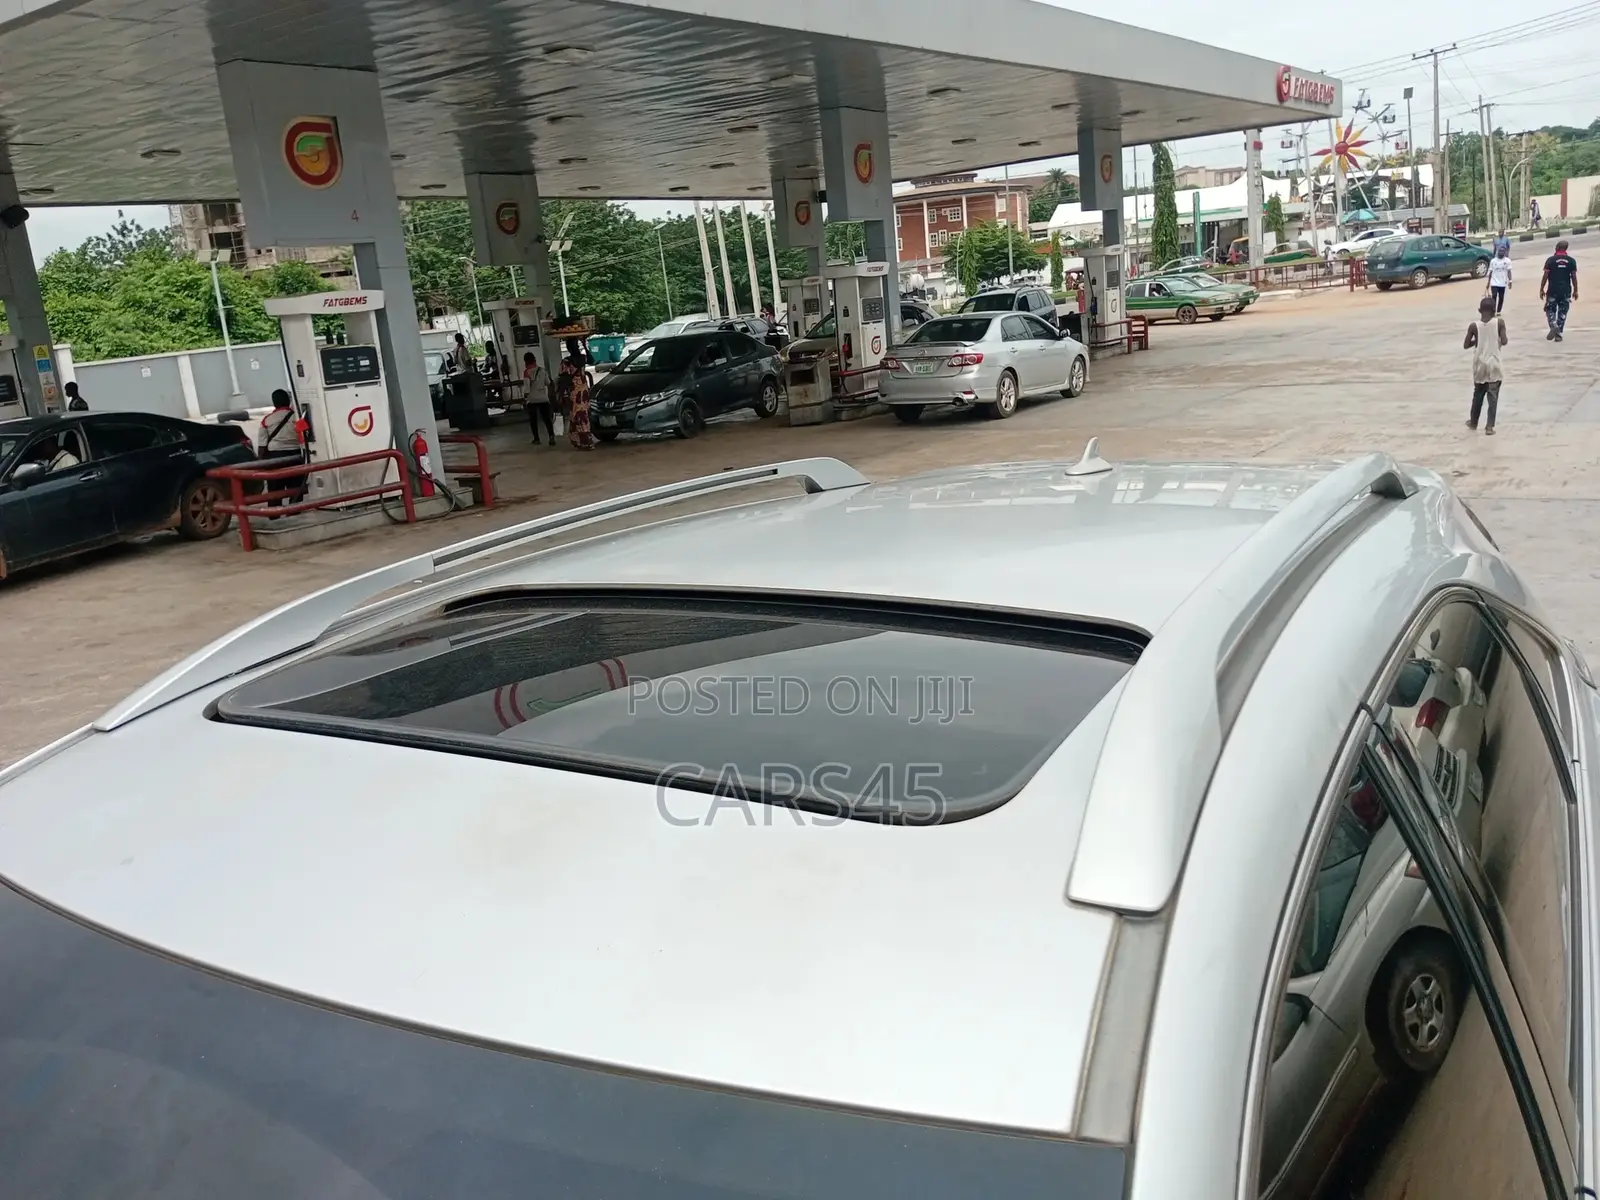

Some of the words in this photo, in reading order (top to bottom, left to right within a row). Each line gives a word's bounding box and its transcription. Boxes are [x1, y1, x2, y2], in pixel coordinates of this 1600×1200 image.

[1291, 75, 1336, 104] FATGBEMS
[351, 209, 359, 223] 4
[323, 296, 368, 308] FATGBEMS
